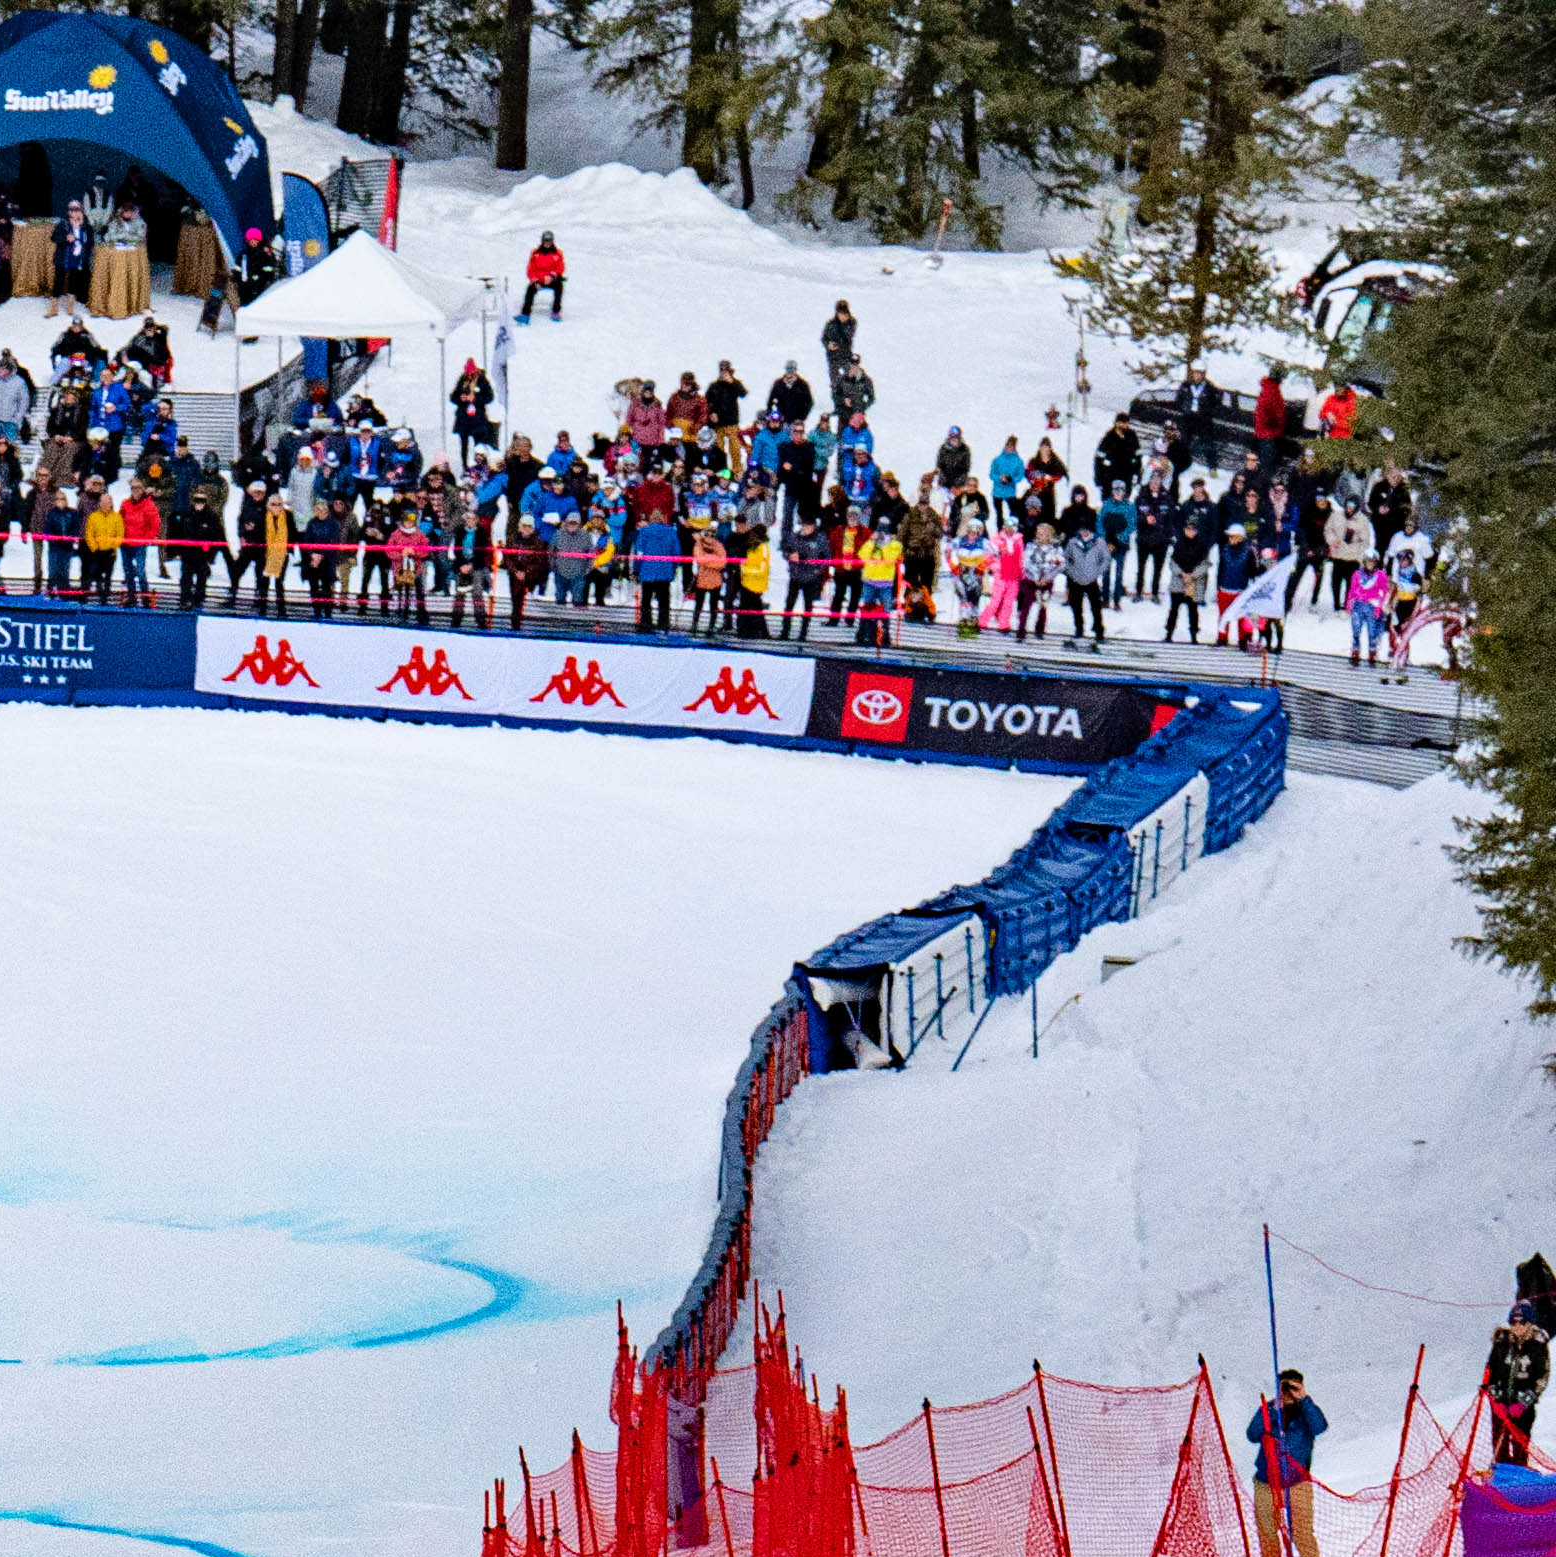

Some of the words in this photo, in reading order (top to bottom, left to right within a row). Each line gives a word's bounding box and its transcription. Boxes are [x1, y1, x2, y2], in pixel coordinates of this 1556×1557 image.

[22, 655, 48, 669] SKI
[50, 656, 93, 671] TEAM
[924, 696, 1083, 740] TOYOTA
